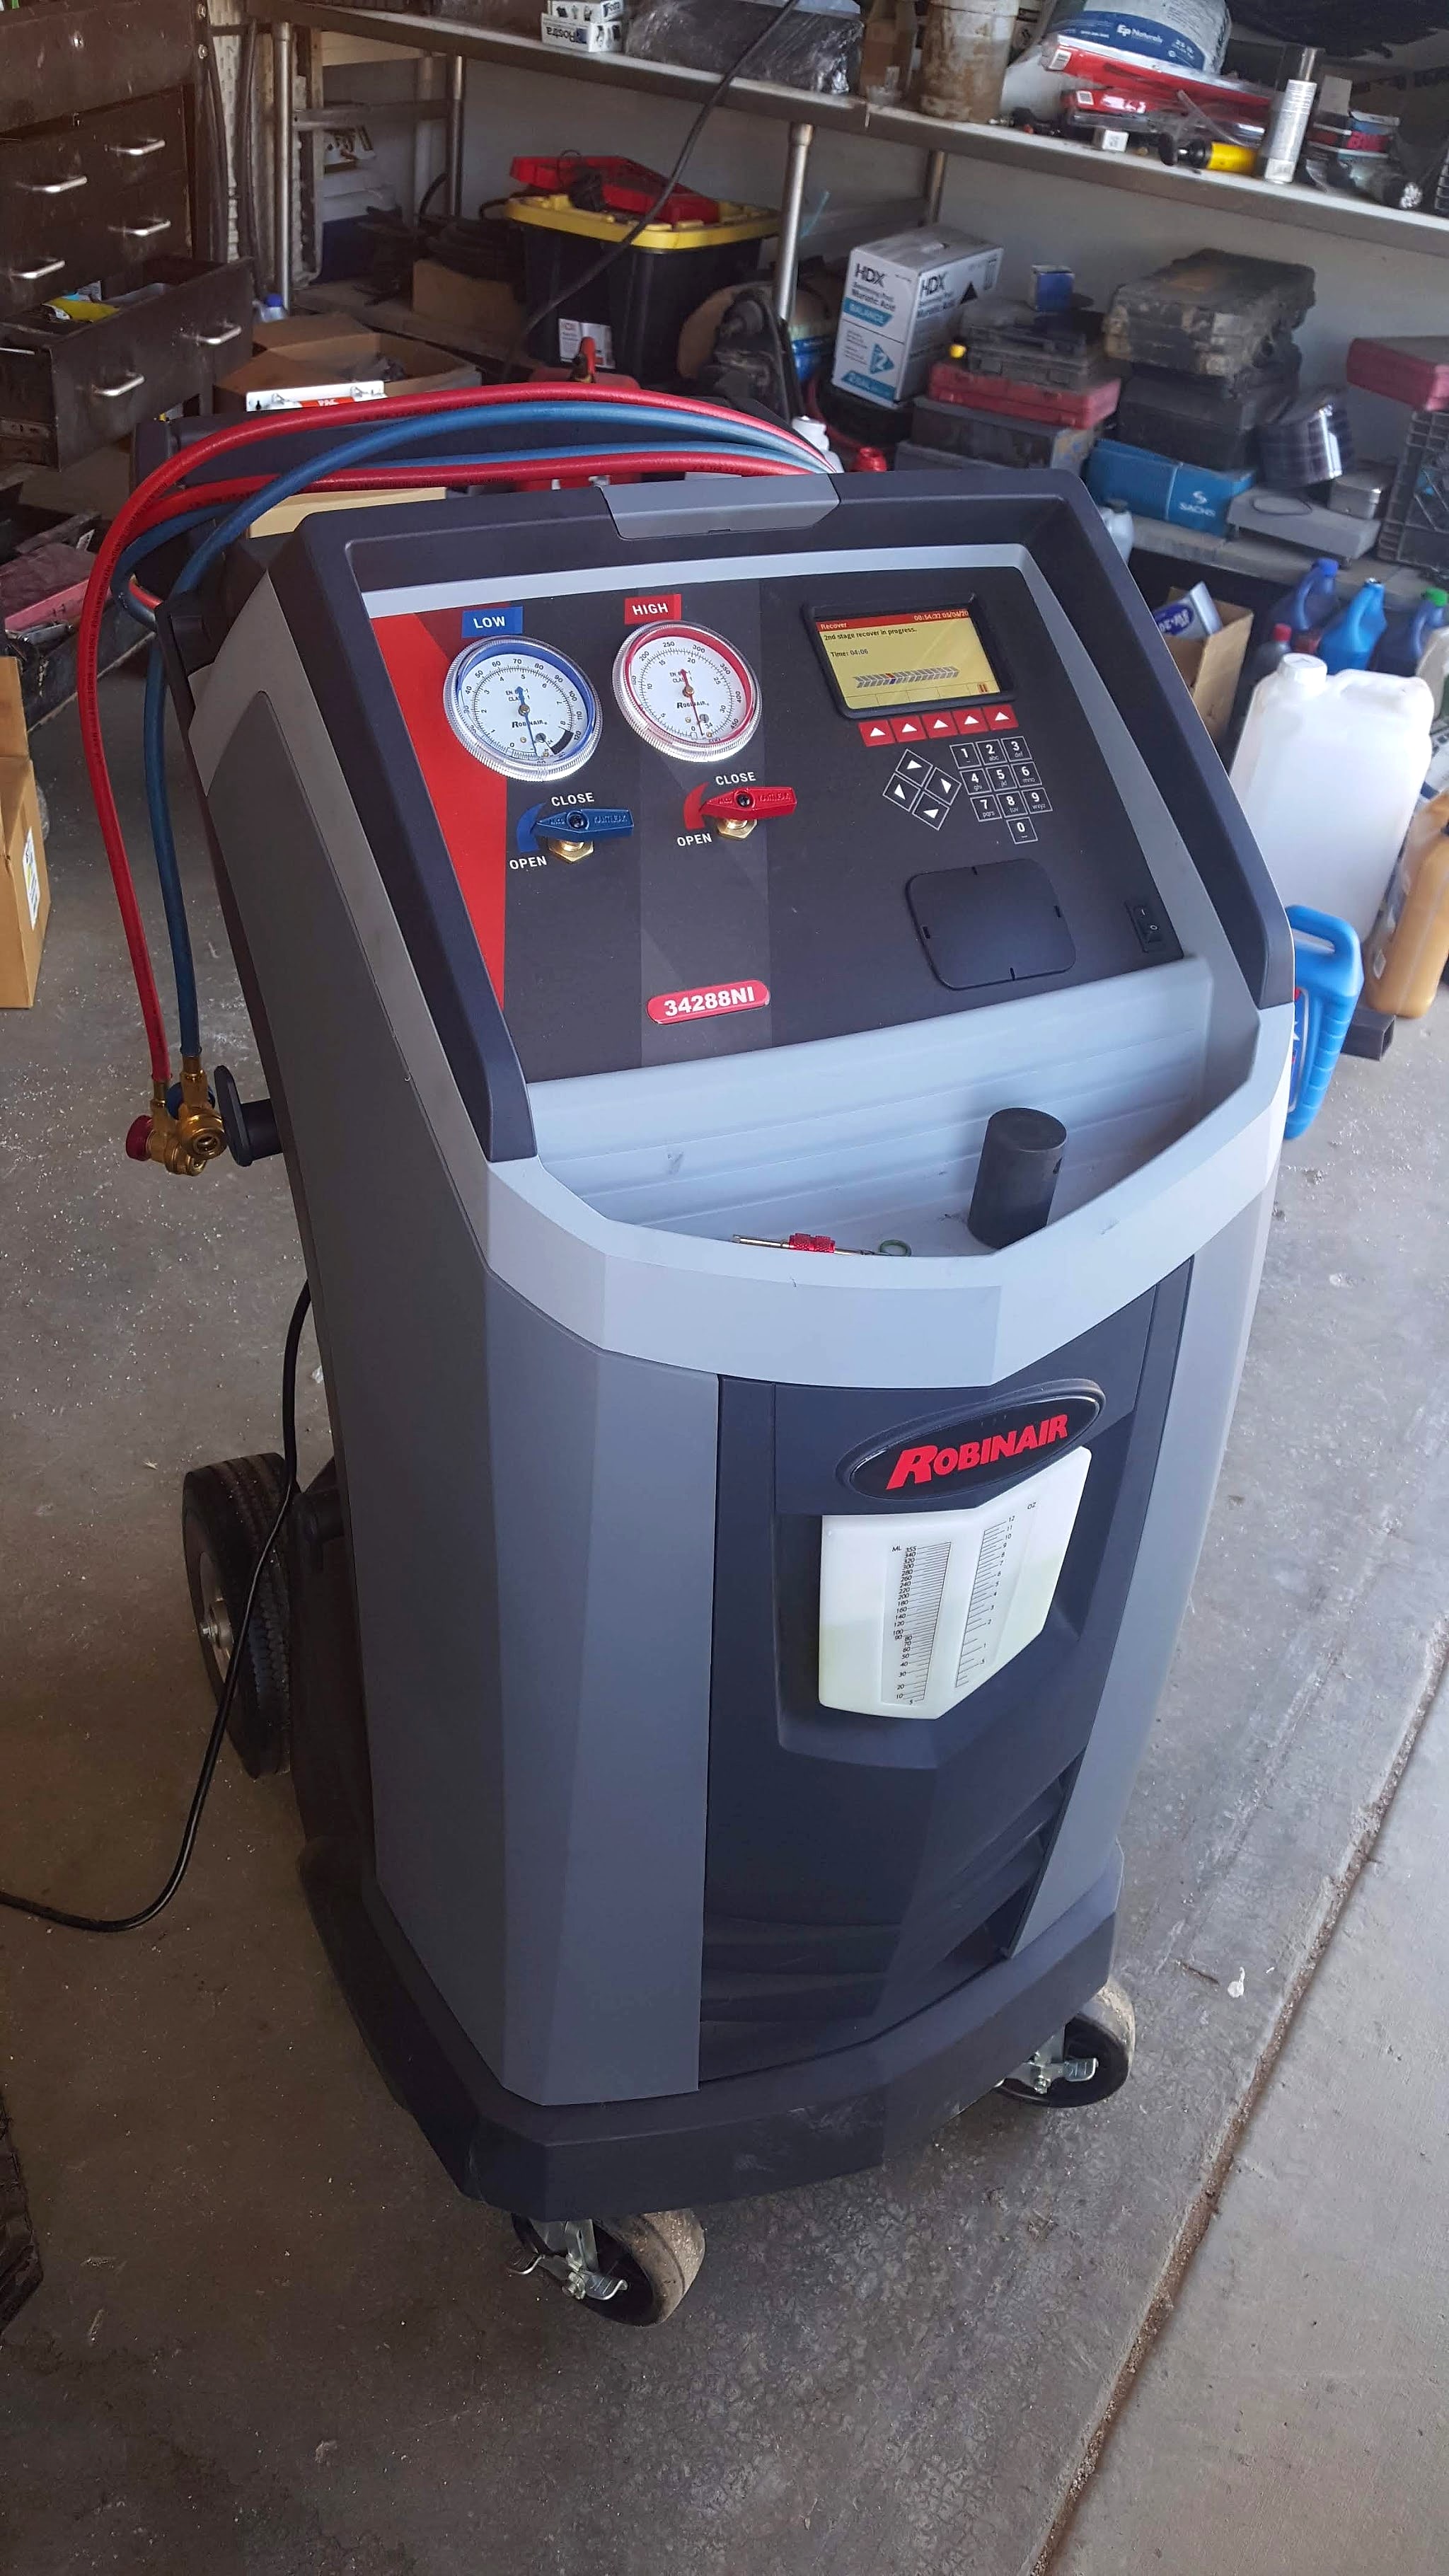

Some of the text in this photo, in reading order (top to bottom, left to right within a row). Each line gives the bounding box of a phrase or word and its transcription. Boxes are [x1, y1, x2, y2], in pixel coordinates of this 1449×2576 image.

[855, 263, 885, 287] HDX
[921, 272, 947, 296] HDX
[632, 603, 668, 616] HIGH
[473, 616, 505, 628] LOW
[888, 627, 918, 635] progress.
[692, 645, 705, 654] 300
[639, 651, 650, 662] 200
[720, 663, 731, 675] 350
[554, 674, 563, 683] 90
[465, 686, 472, 695] 40
[568, 691, 577, 702] 100
[730, 718, 739, 730] 450
[986, 744, 994, 754] 2
[1011, 741, 1020, 751] 3
[961, 748, 969, 758] 1
[996, 769, 1005, 780] 5
[1021, 766, 1029, 776] 6
[715, 772, 756, 786] CLOSE
[971, 773, 979, 783] 4
[551, 792, 595, 807] CLOSE
[1006, 795, 1015, 806] 8
[1031, 792, 1039, 802] 9
[980, 799, 988, 809] 7
[1017, 822, 1025, 832] 0
[677, 833, 712, 848] OPEN
[509, 855, 547, 870] OPEN
[664, 986, 756, 1017] 34288NI
[886, 1414, 1068, 1490] ROBINAIR
